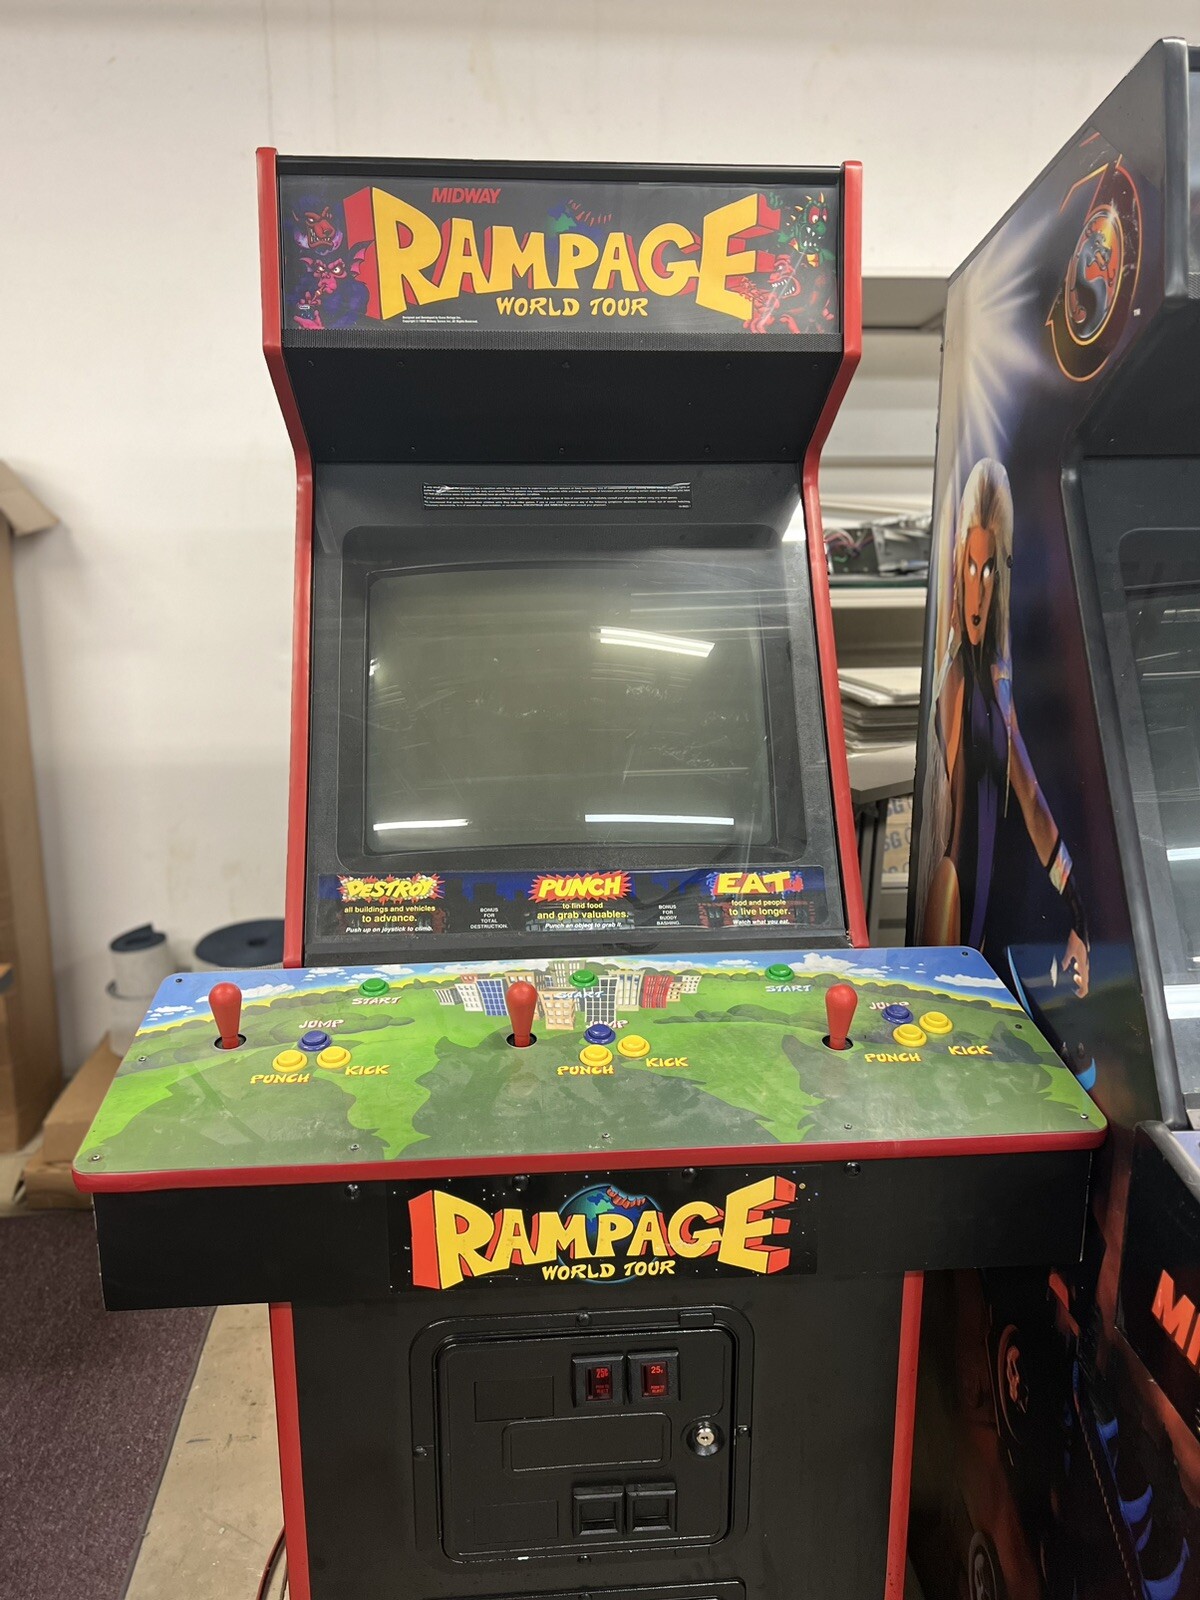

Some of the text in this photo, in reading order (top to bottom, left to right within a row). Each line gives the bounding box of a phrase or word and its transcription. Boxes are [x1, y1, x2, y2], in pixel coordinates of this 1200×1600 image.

[432, 187, 501, 205] MIDWAY
[343, 186, 782, 322] RAMPAGE
[495, 297, 649, 317] WORLD TOUR
[538, 876, 622, 898] PUNCH
[718, 871, 790, 893] EAT
[346, 878, 434, 898] DESTROY
[571, 902, 586, 910] find
[763, 900, 787, 908] people
[344, 905, 353, 913] all
[354, 905, 389, 915] buildings
[406, 905, 436, 913] vehicles
[537, 910, 629, 921] and grab valuables.
[729, 907, 791, 918] to live longer.
[362, 914, 418, 923] to advance.
[601, 922, 616, 930] grab
[765, 984, 812, 993] START
[553, 990, 605, 1000] START
[351, 996, 402, 1006] START
[299, 1019, 345, 1029] JUMP
[948, 1045, 993, 1057] KICK
[645, 1056, 690, 1068] KICK
[864, 1053, 922, 1063] PUNCH
[345, 1065, 390, 1076] KICK
[556, 1064, 615, 1077] PUNCH
[250, 1073, 310, 1084] PUNCH
[407, 1175, 797, 1290] RAMPAGE
[541, 1258, 676, 1281] WORLD TOUR
